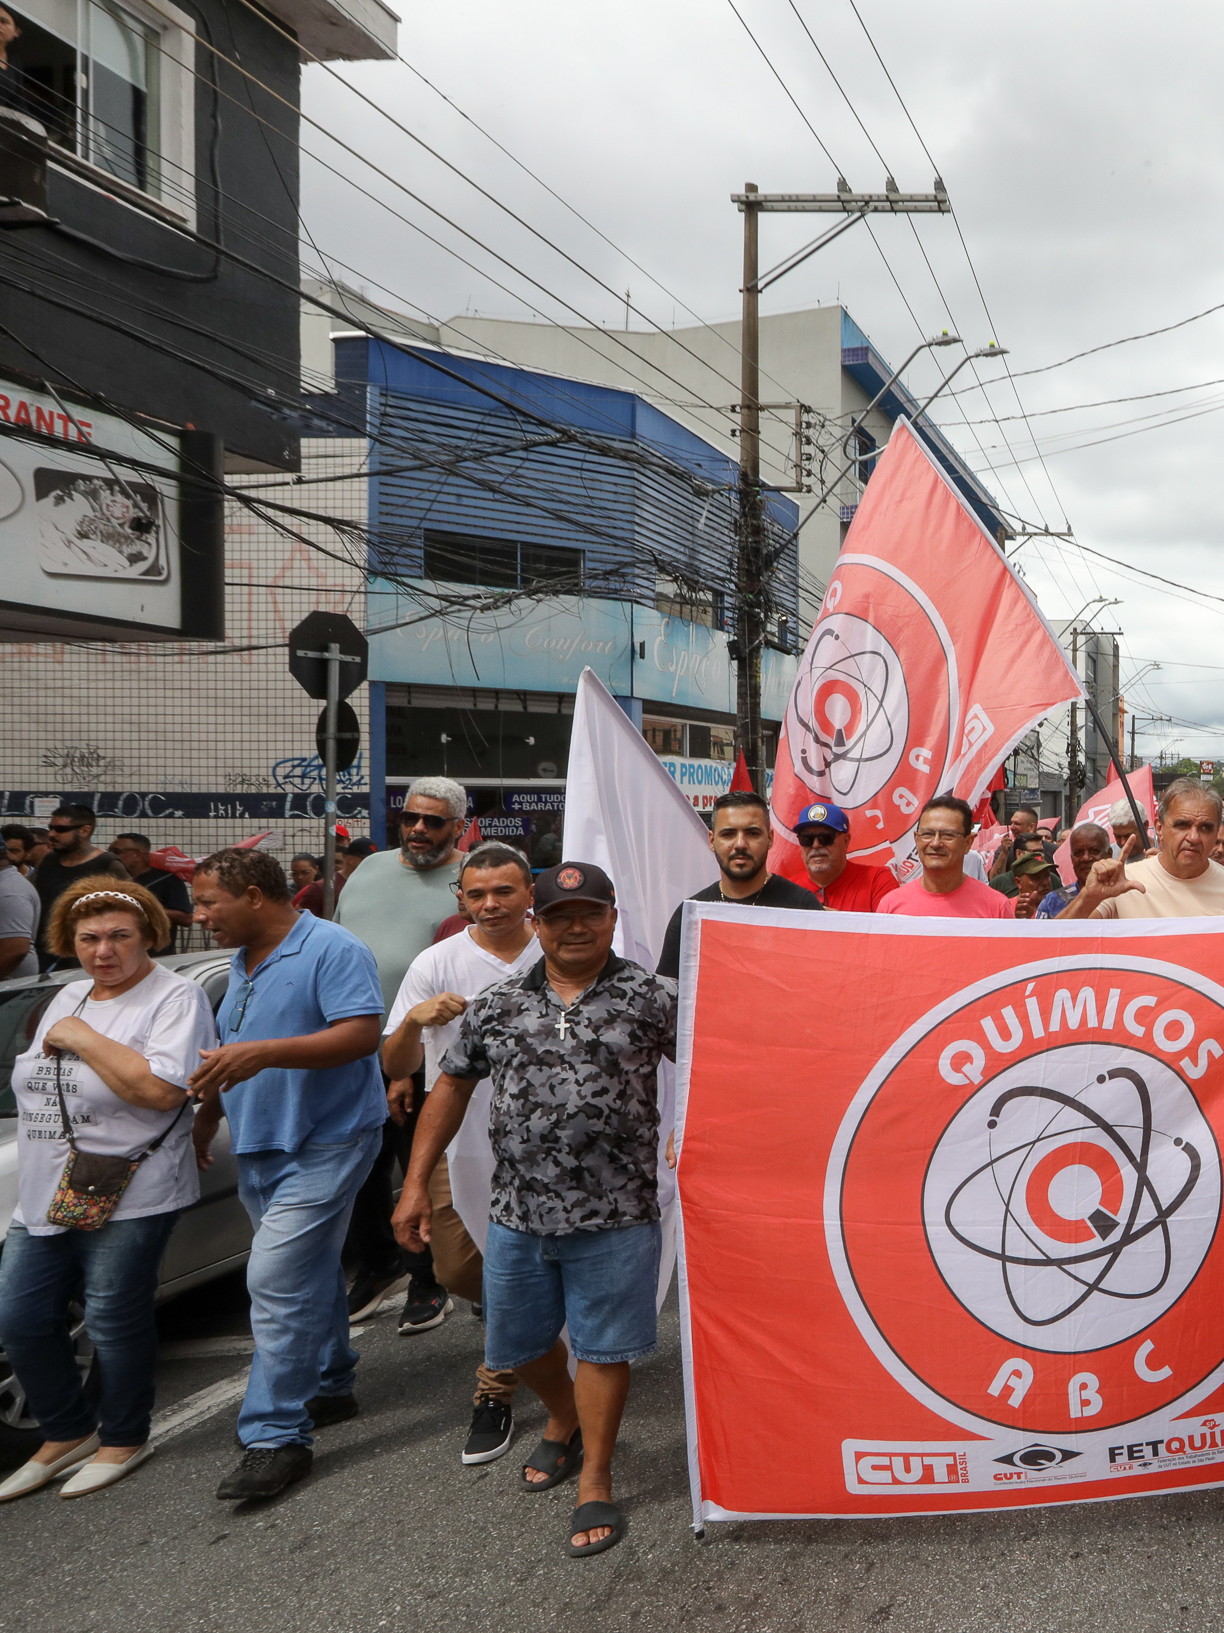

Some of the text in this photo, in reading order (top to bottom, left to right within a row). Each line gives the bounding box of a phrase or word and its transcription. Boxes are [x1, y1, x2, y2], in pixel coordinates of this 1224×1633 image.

[512, 794, 538, 803] AQUI
[480, 826, 524, 836] MEDIDA
[938, 982, 1224, 1086] QUÍMICOS
[36, 1066, 73, 1077] BRUAS
[27, 1081, 47, 1092] QUE
[857, 1452, 970, 1484] CUT BRASIL
[993, 1472, 1023, 1481] CUT
